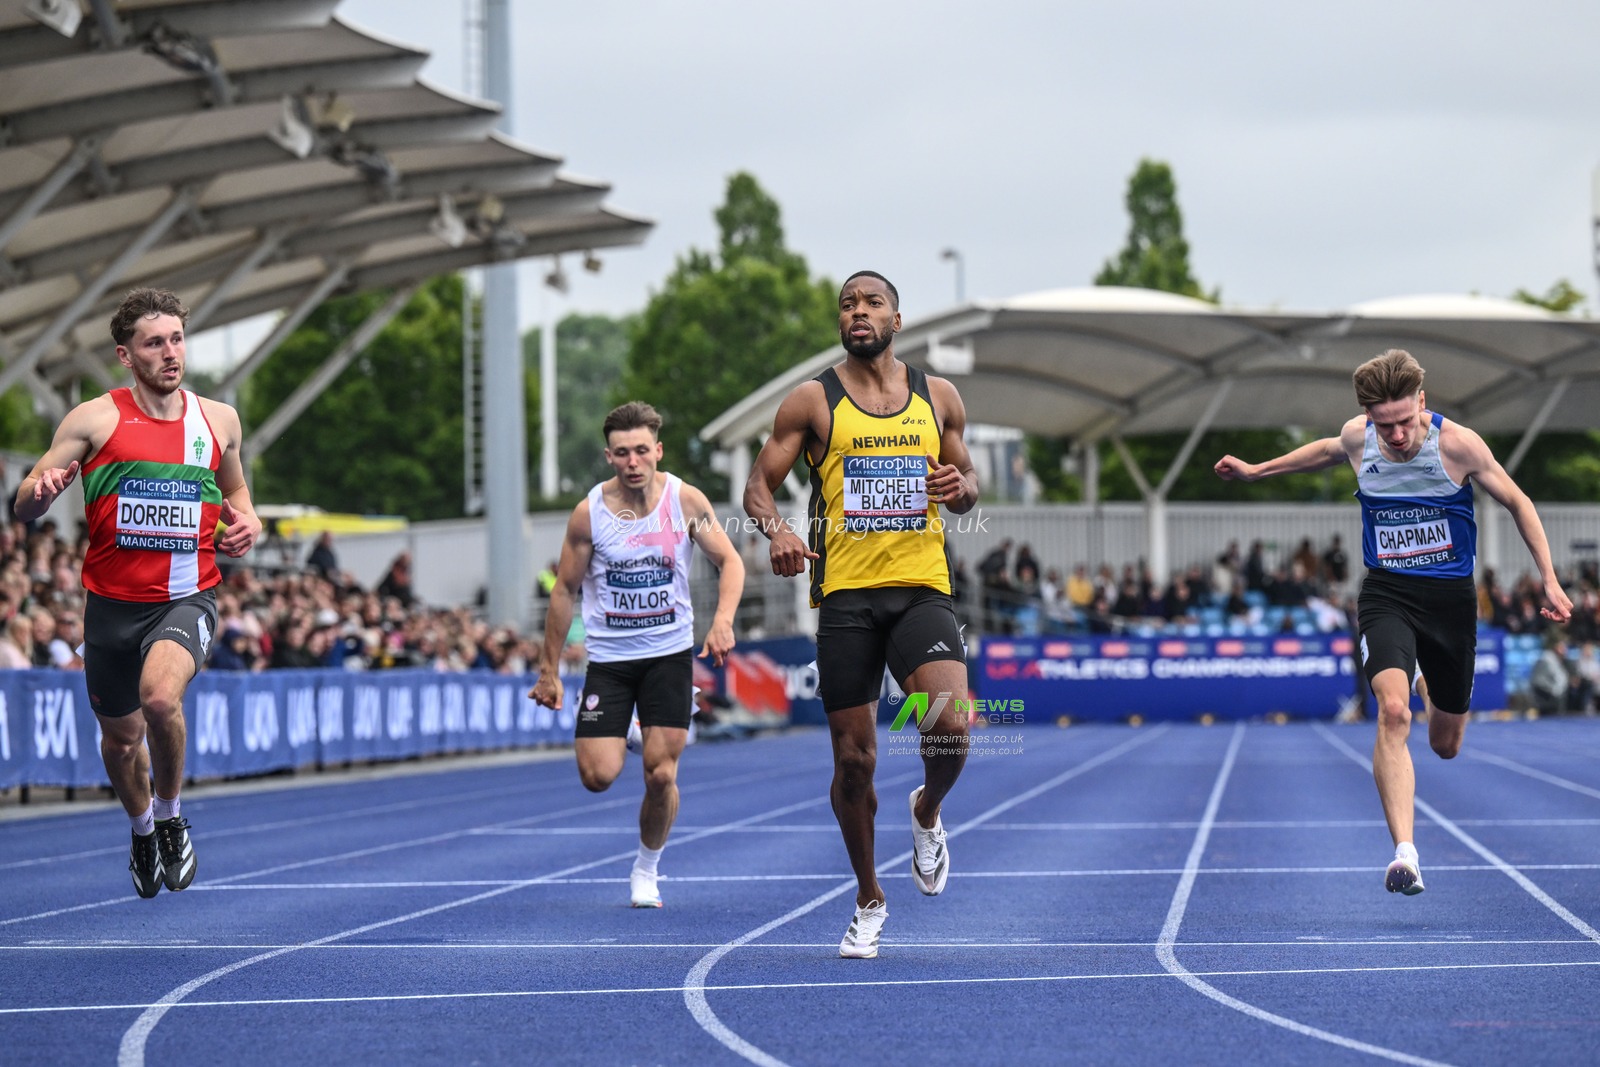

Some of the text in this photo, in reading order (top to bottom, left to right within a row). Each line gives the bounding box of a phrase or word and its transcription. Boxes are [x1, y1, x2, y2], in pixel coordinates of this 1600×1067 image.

[853, 434, 921, 449] NEWHAM
[850, 478, 923, 494] MITCHELL
[861, 494, 912, 510] BLAKE
[121, 503, 197, 529] DORRELL
[849, 517, 922, 528] MANCHESTER
[120, 535, 194, 550] MANCHESTER
[1379, 523, 1447, 550] CHAPMAN
[607, 555, 672, 569] ENGLAND
[1382, 551, 1449, 568] MANCHESTER
[611, 590, 670, 610] TAYLOR
[609, 614, 671, 627] MANCHESTER
